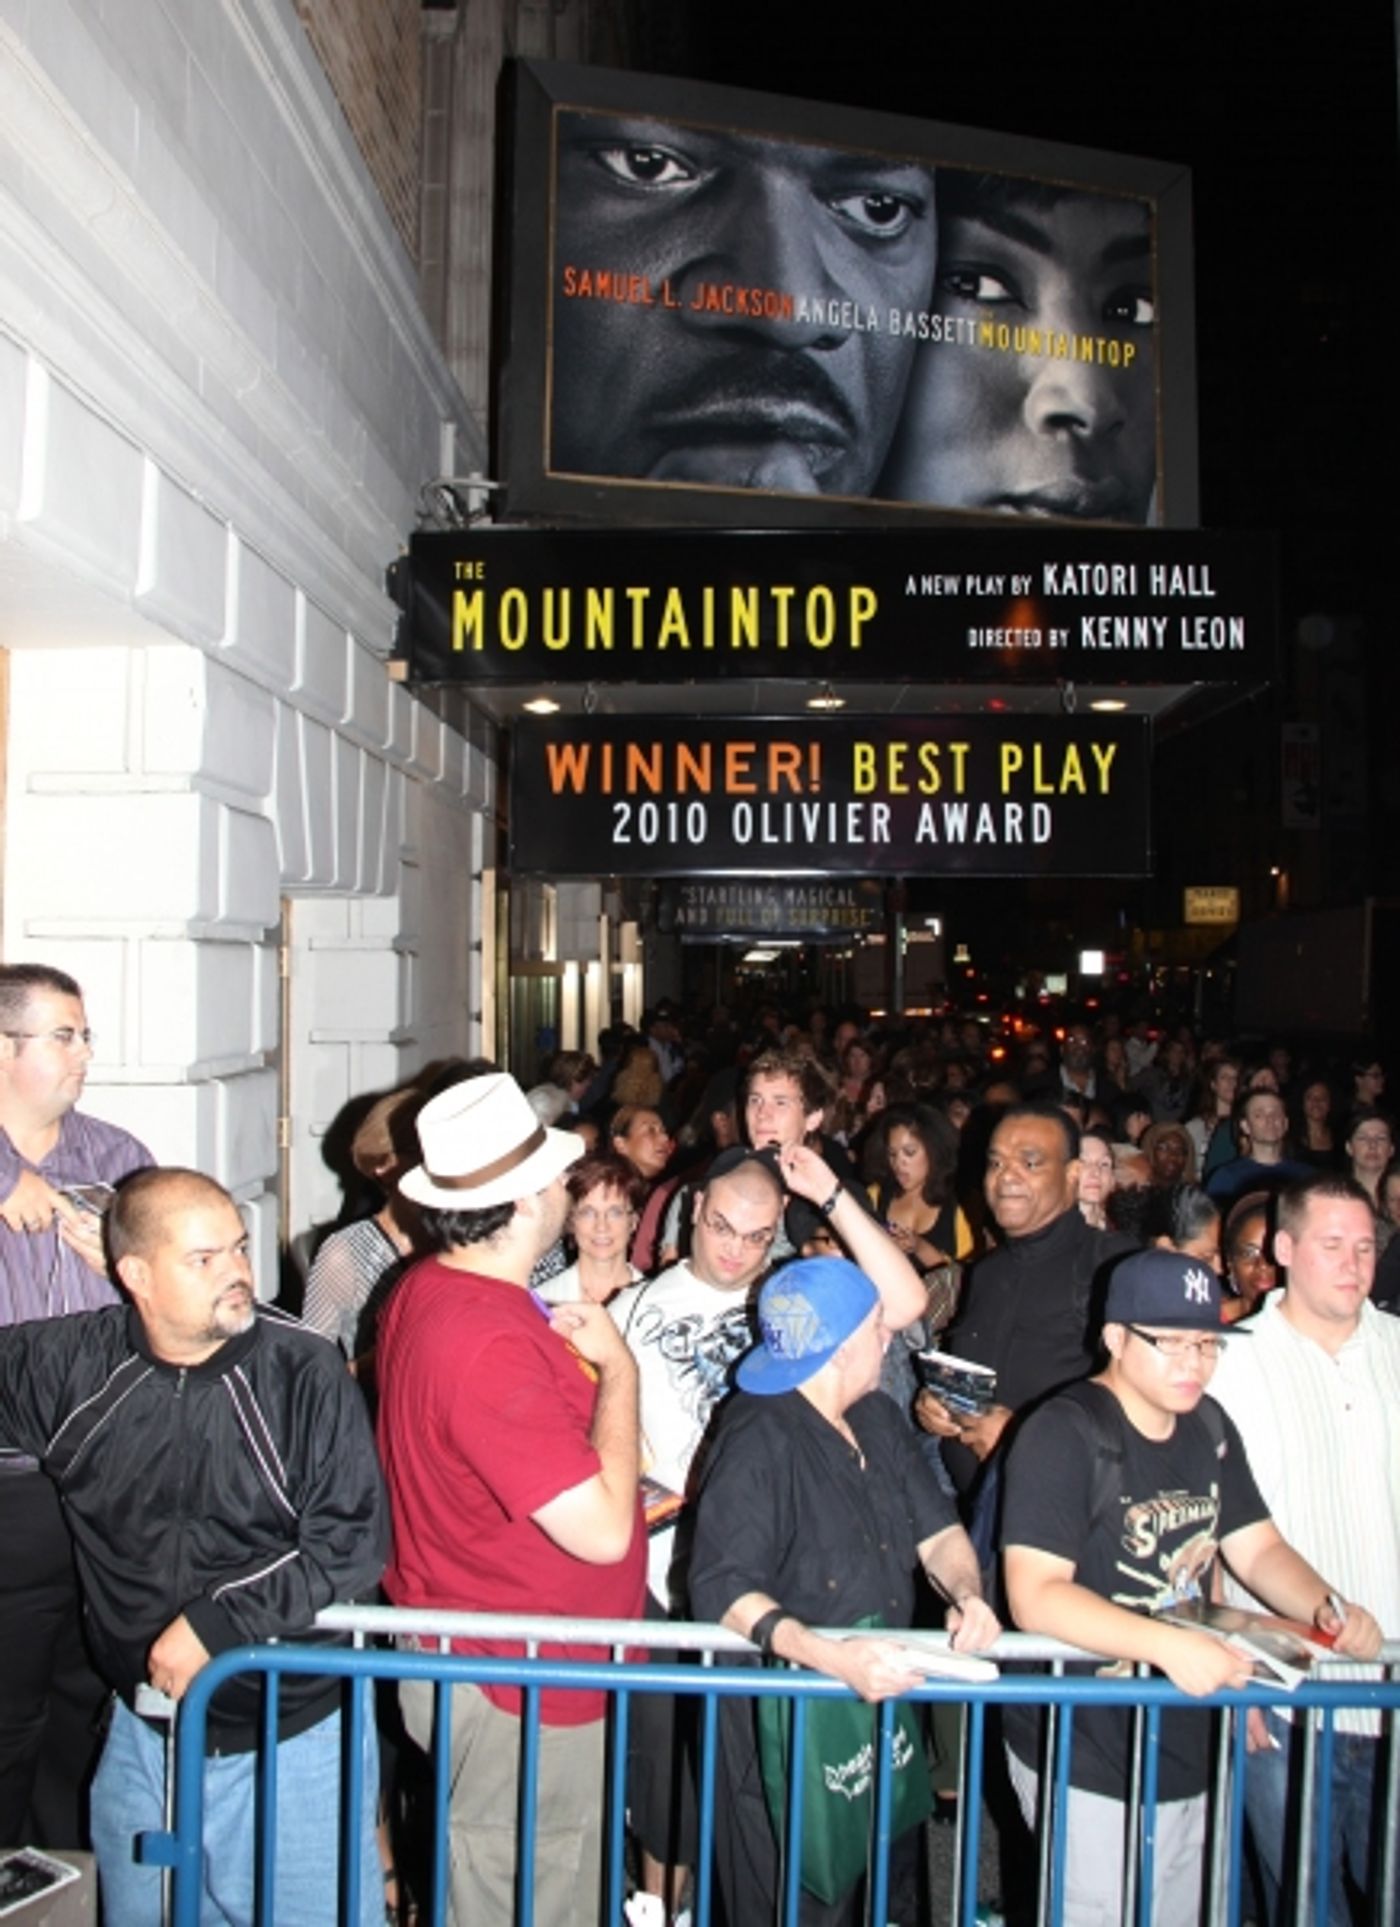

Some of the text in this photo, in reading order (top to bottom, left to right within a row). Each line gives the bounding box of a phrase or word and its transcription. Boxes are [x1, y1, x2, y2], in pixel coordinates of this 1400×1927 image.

[564, 266, 1136, 368] SAMUEL L. JACKSON ANGELA BASSETT MOUNTAINTOP
[454, 561, 485, 580] THE
[905, 563, 1217, 597] A NEW PLAY BY KATORI HALL
[452, 585, 878, 651] MOUNTAINTOP
[968, 616, 1245, 650] DIRECTED BY KENNY LEON
[546, 742, 1117, 794] WINNER! BEST PLAY
[613, 801, 1052, 844] 2010 OLIVIER AWARD
